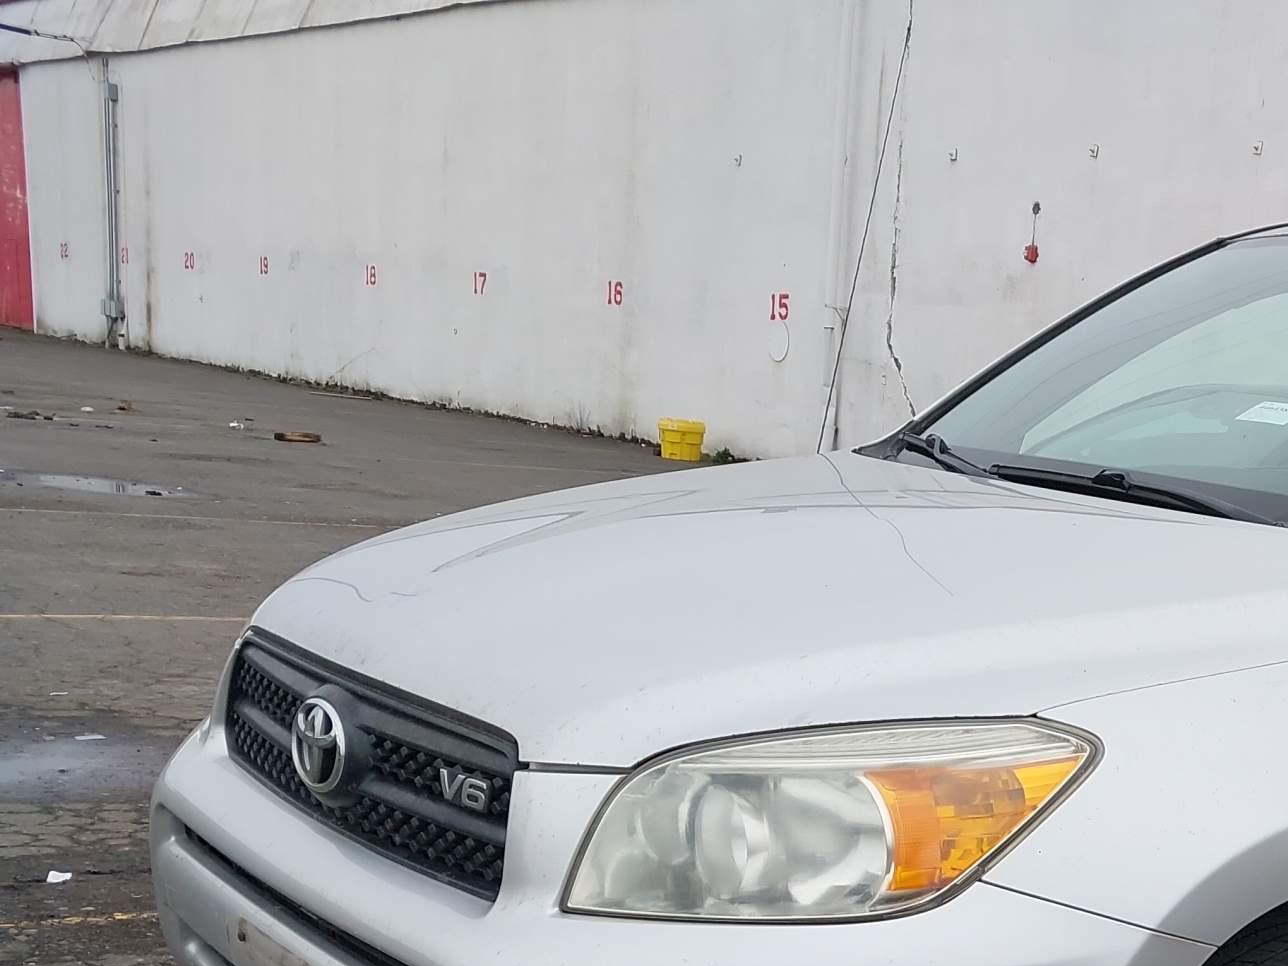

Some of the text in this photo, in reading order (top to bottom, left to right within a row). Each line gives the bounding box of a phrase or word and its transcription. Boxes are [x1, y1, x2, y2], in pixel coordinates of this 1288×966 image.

[184, 252, 195, 269] 20
[259, 256, 269, 274] 19
[366, 264, 377, 285] 18
[474, 271, 487, 295] 17
[607, 280, 623, 306] 16
[770, 293, 790, 321] 15
[439, 768, 487, 810] V6
